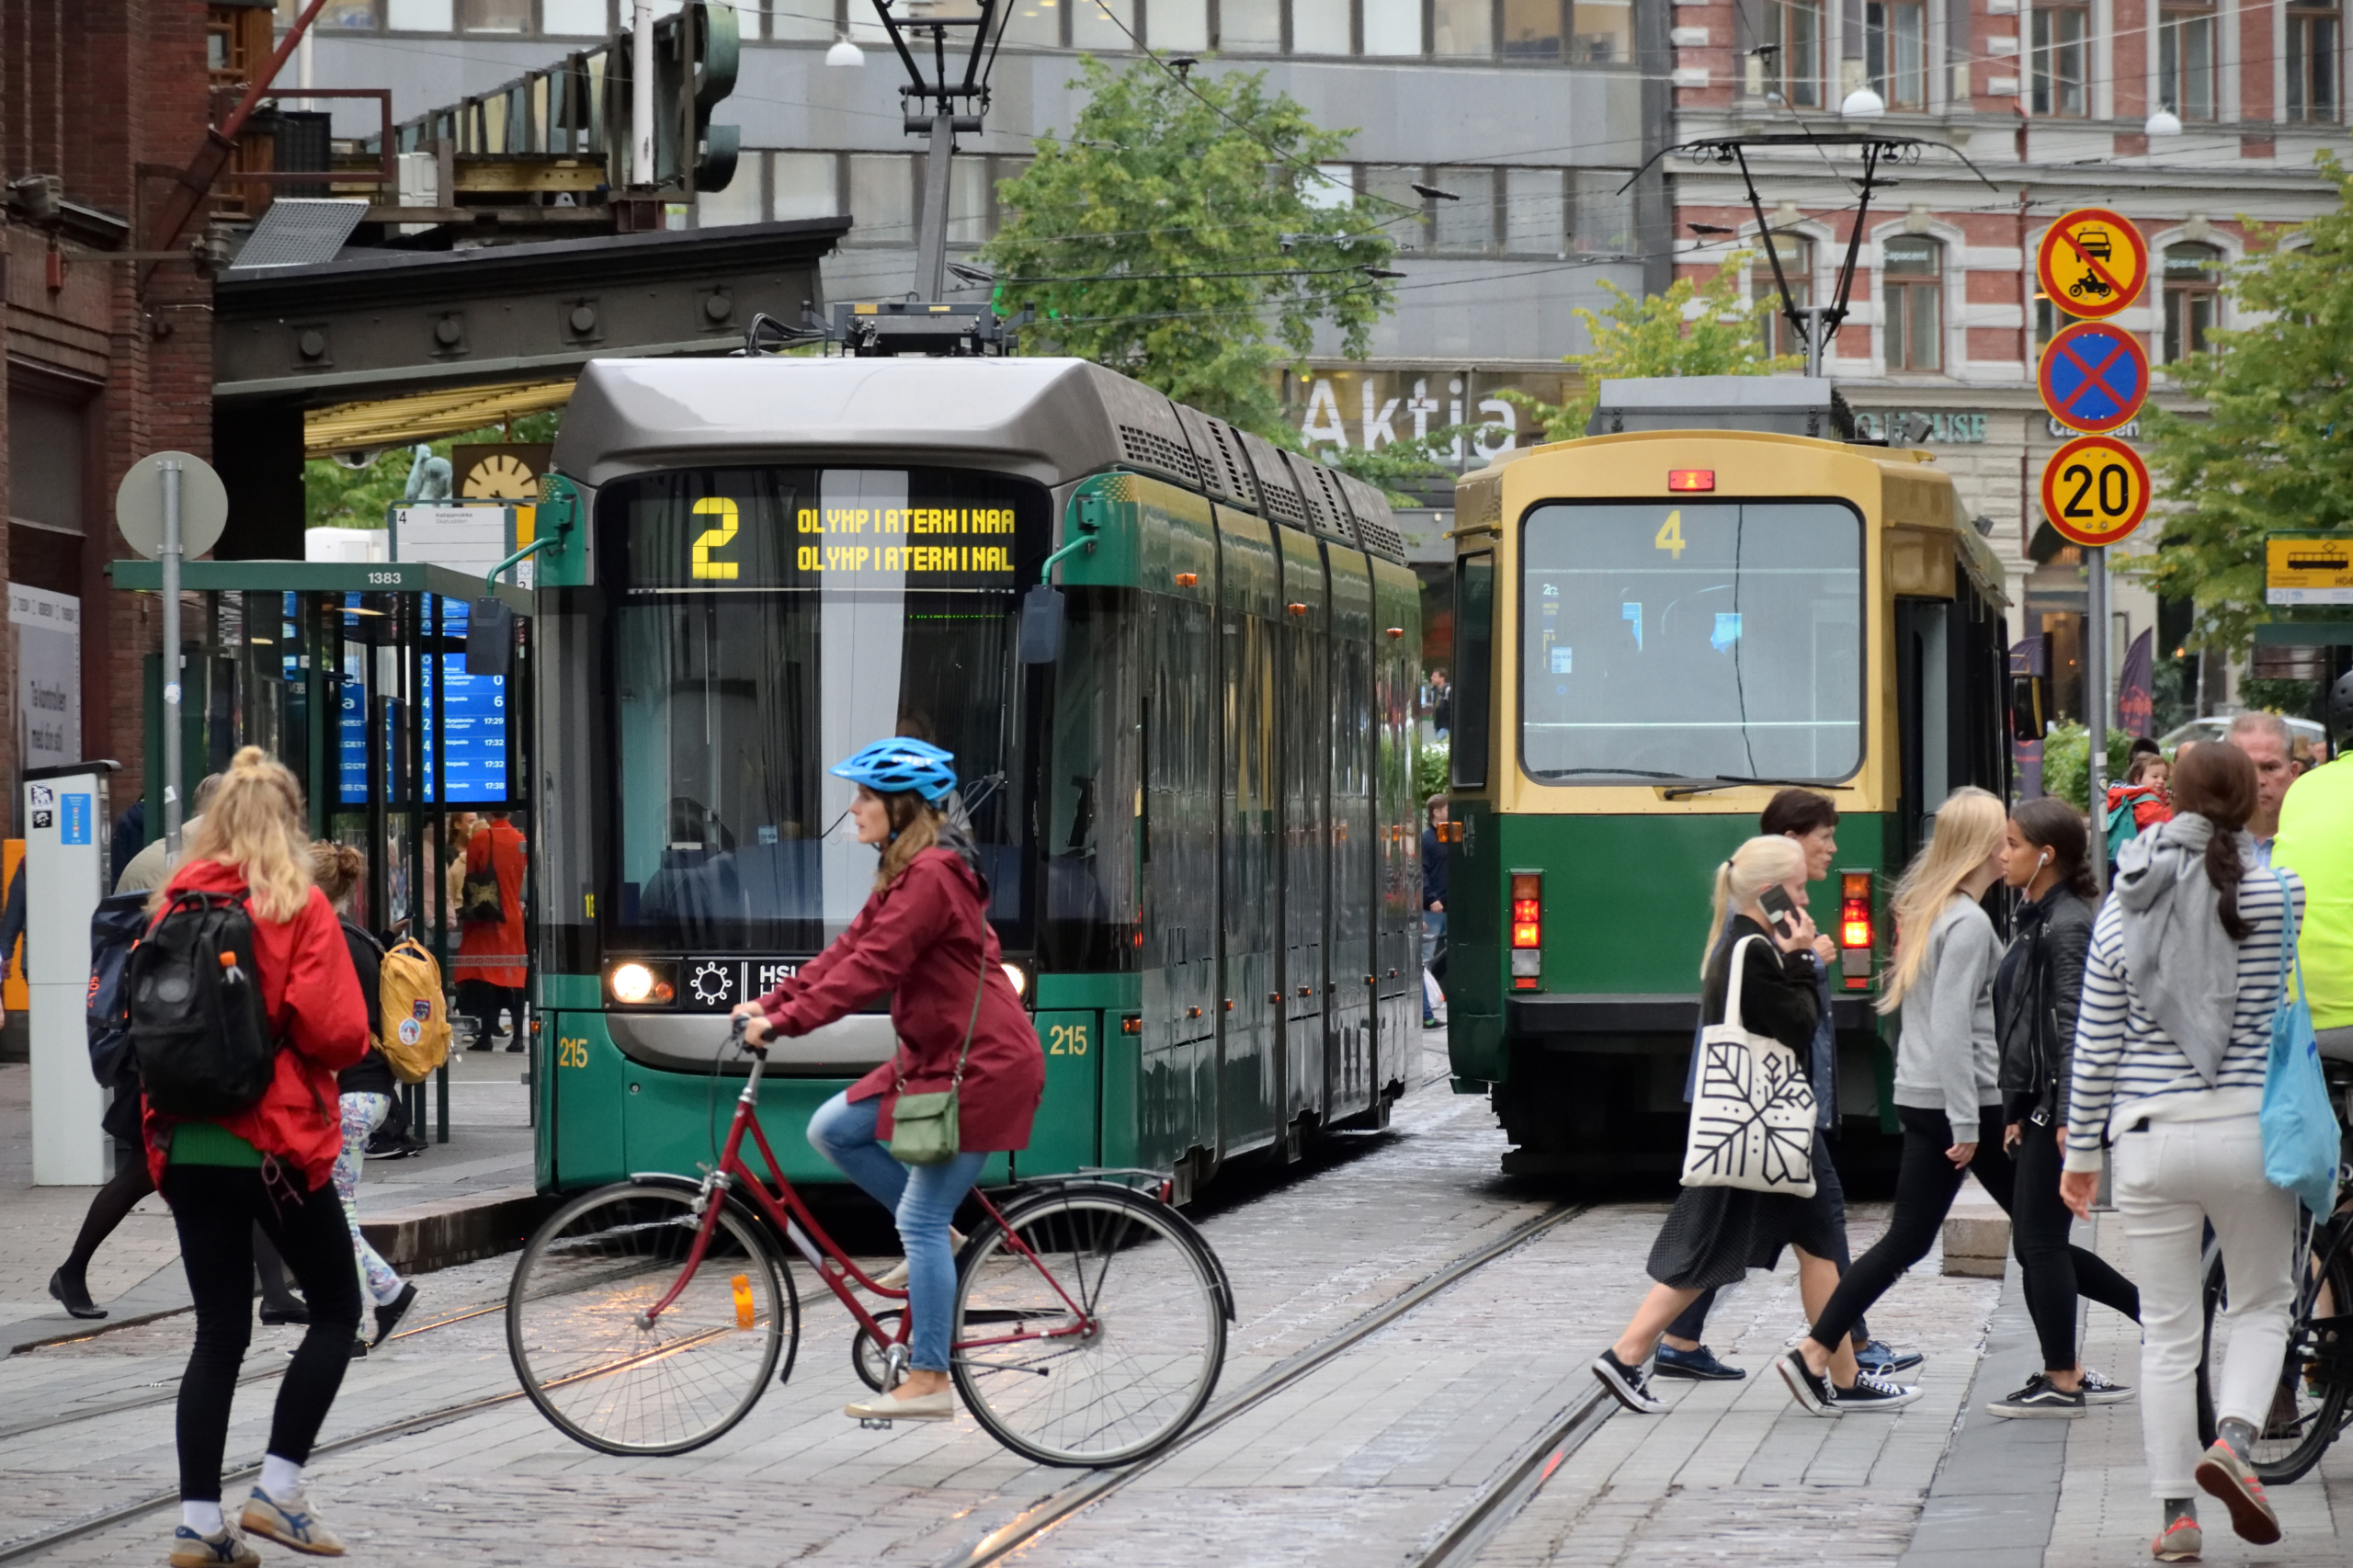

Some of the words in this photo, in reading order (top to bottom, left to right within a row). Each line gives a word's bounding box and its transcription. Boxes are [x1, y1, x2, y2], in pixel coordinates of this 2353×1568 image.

[1301, 378, 1517, 461] Aktia
[2063, 463, 2129, 517] 20
[398, 510, 407, 525] 4
[797, 508, 1016, 534] OLYMPIATERMINAA
[692, 496, 738, 579] 2
[1655, 509, 1686, 561] 4
[797, 546, 1016, 572] OLYMPIATERMINAL
[368, 572, 402, 584] 1383
[422, 675, 430, 687] 2
[493, 675, 504, 686] 0
[422, 697, 431, 709] 4
[494, 695, 504, 708] 6
[423, 718, 431, 731] 2
[483, 717, 505, 725] 17:29
[423, 739, 431, 752] 4
[423, 761, 431, 774] 4
[484, 760, 506, 768] 17:32
[424, 783, 432, 796] 4
[1050, 1025, 1087, 1055] 215
[559, 1037, 588, 1068] 215
